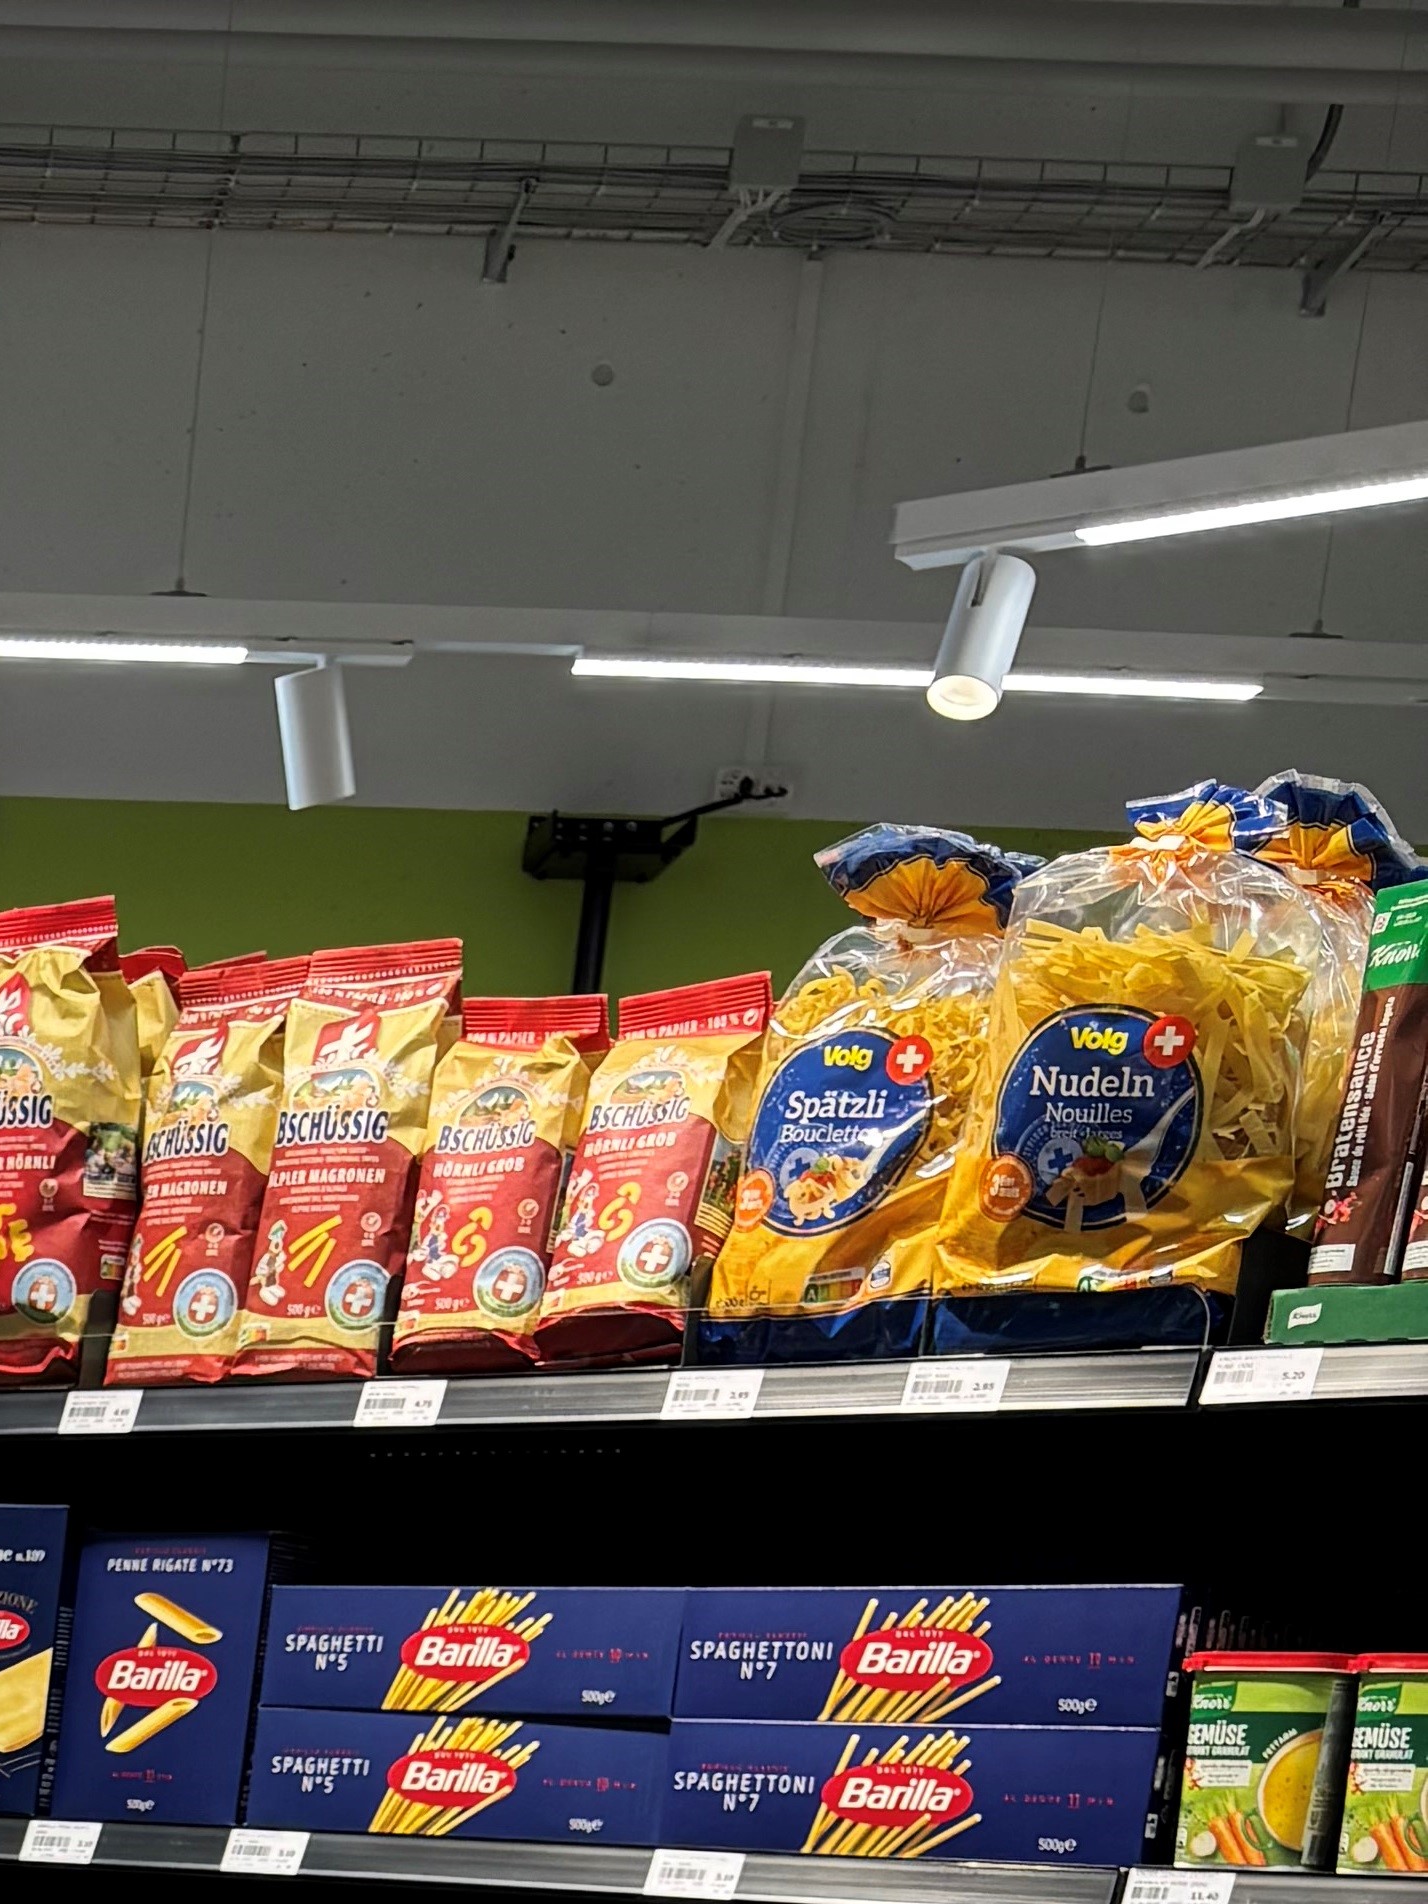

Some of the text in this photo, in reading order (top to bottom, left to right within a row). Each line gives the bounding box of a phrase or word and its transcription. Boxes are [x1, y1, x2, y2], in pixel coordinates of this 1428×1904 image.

[1070, 1026, 1128, 1053] Volg
[822, 1043, 874, 1070] Volg
[1031, 1065, 1155, 1100] Nudeln
[588, 1095, 691, 1132] BSCHÜSSIG
[785, 1090, 887, 1123] Spätzli
[1045, 1102, 1133, 1126] Nouilles
[277, 1109, 389, 1148] BSCHÜSSIG
[436, 1119, 537, 1155] BSCHÜSSIG
[1282, 1371, 1306, 1381] 5.20
[106, 1557, 196, 1574] PENNE RIGATE
[284, 1633, 384, 1655] SPAGHETTI
[413, 1636, 521, 1669] Barilla
[689, 1639, 834, 1661] SPAGHETTONI
[856, 1640, 982, 1676] Barilla
[107, 1659, 208, 1694] Barilla
[270, 1755, 371, 1777] SPAGHETTI
[400, 1760, 507, 1795] Barilla
[672, 1772, 816, 1795] SPAGHETTONI
[837, 1775, 962, 1813] Barilla
